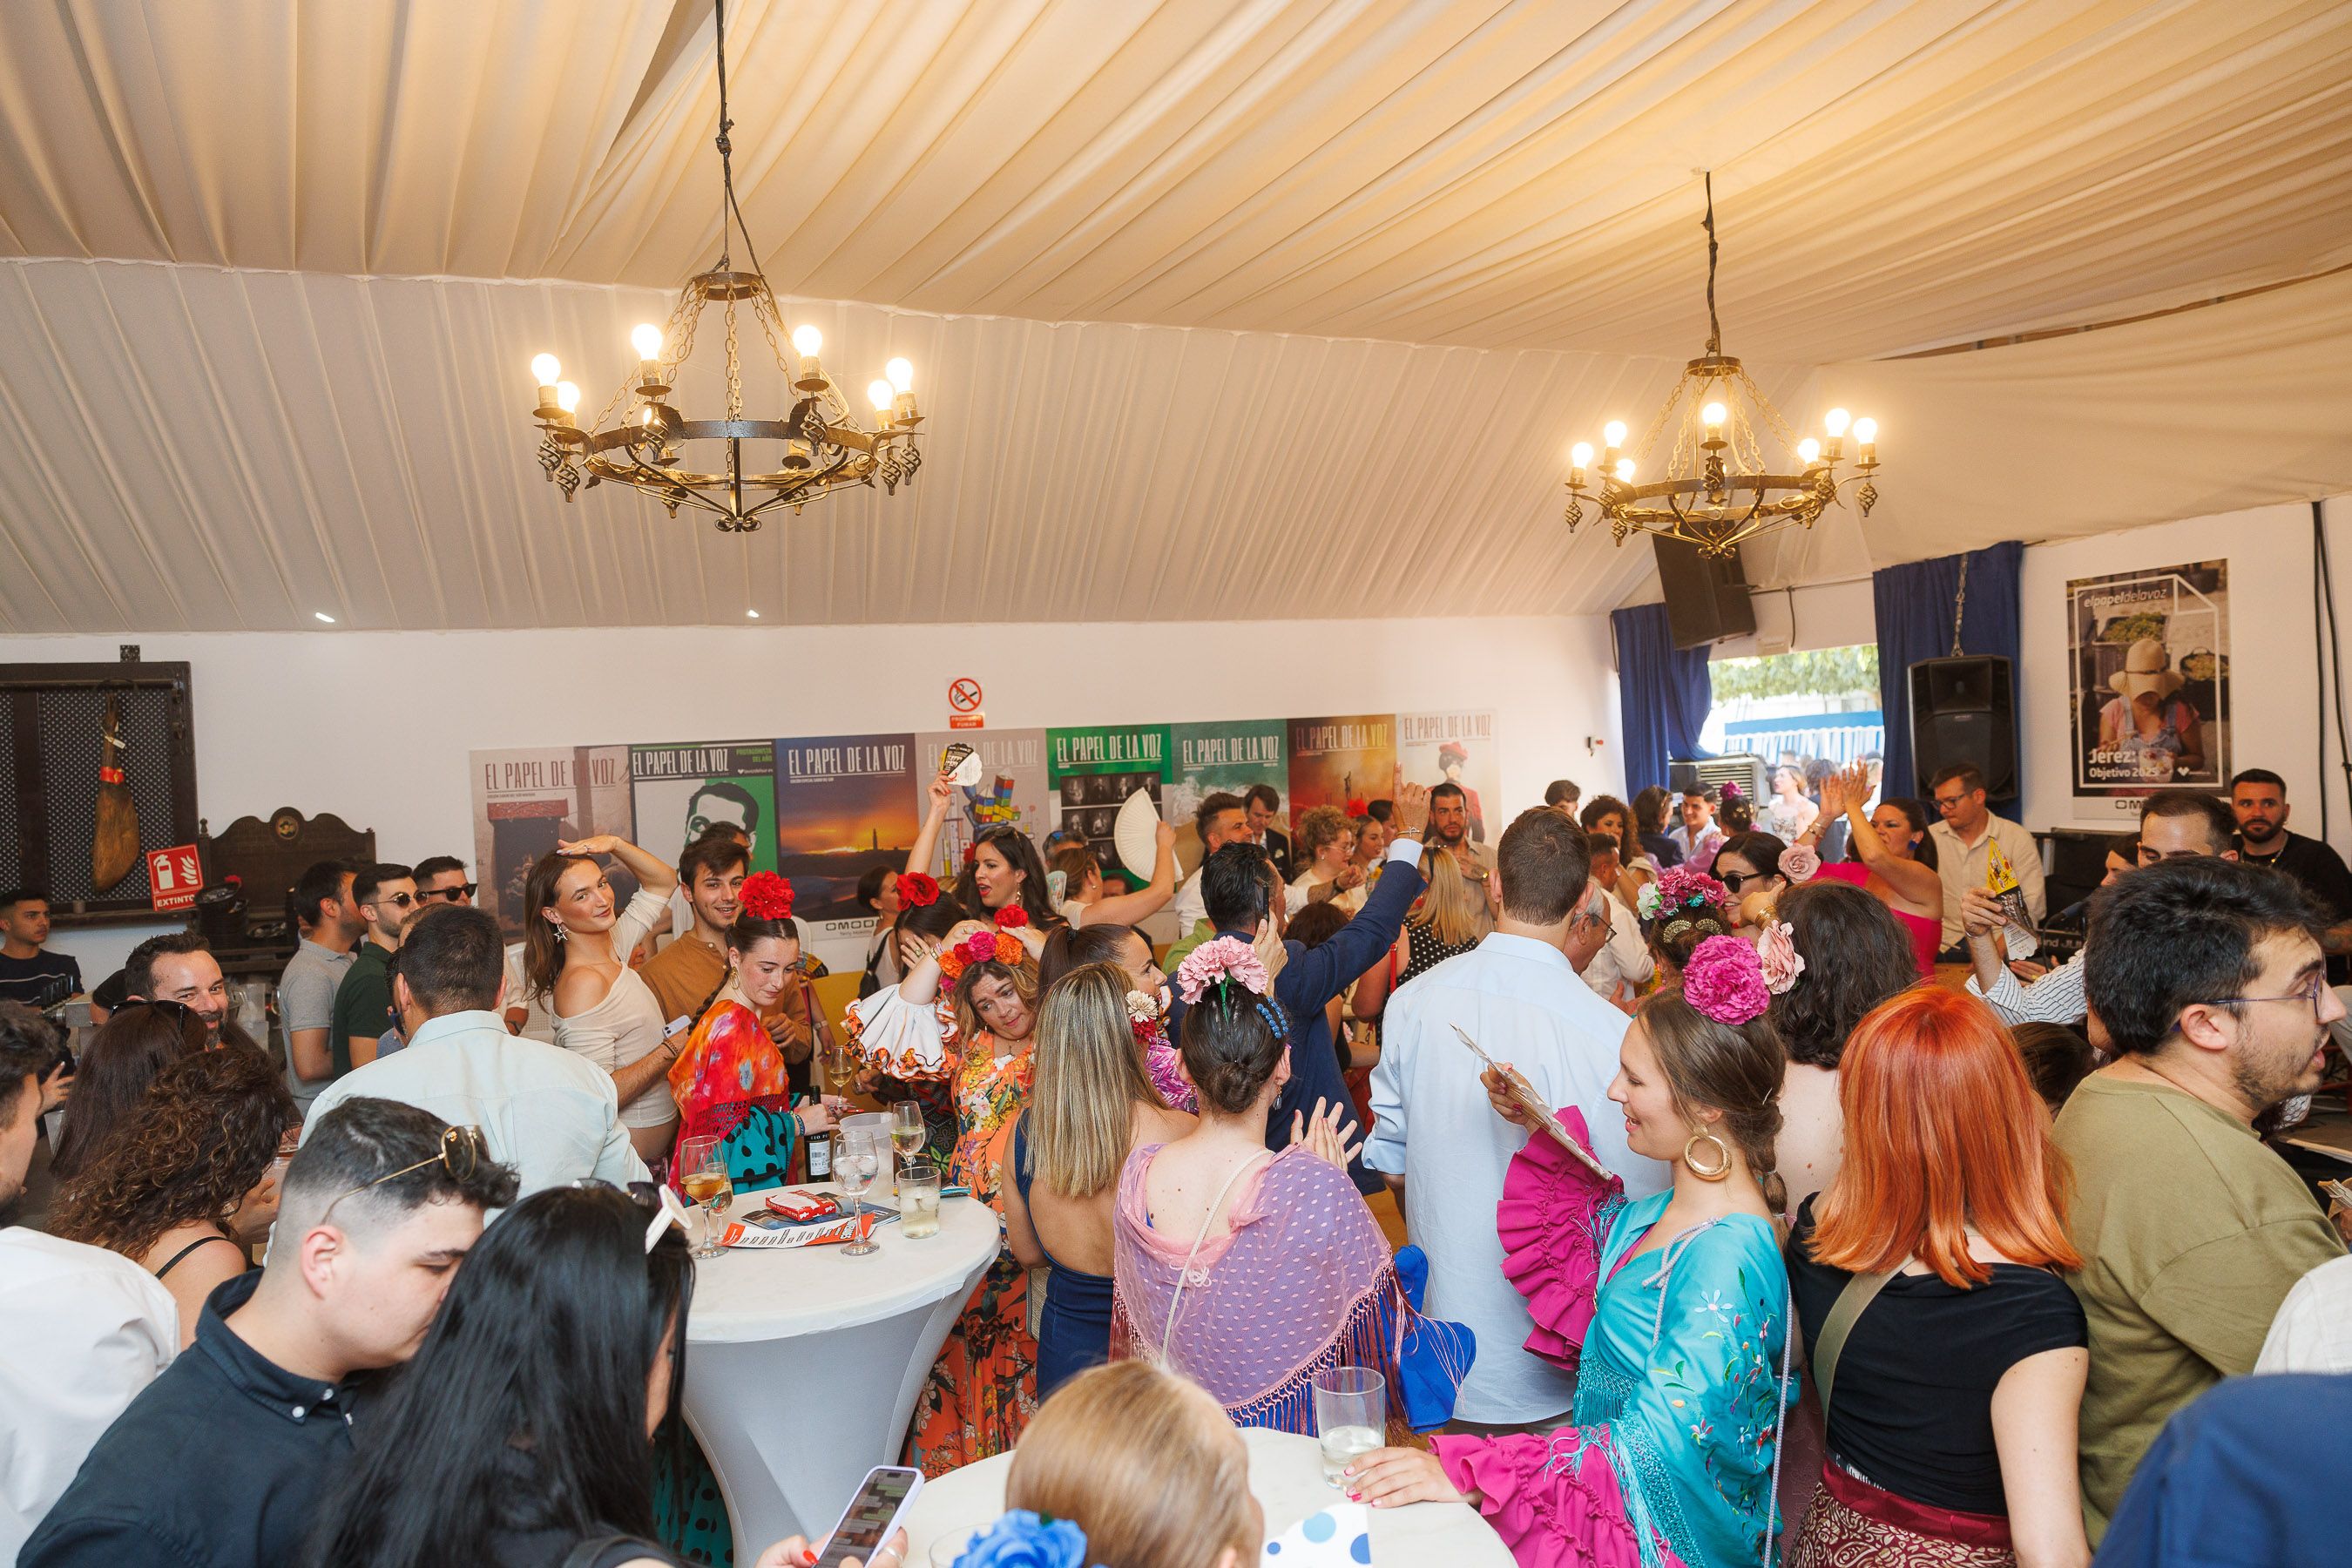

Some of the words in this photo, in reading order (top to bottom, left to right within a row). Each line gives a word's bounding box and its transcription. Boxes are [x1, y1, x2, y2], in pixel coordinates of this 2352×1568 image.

[1296, 727, 1306, 750] EL
[1310, 726, 1338, 749] PAPEL
[1342, 725, 1354, 748] DE
[1356, 724, 1368, 747] LA
[1370, 724, 1388, 747] VOZ
[1405, 718, 1413, 740] EL
[1417, 717, 1443, 739] PAPEL
[1448, 716, 1458, 738] DE
[1463, 715, 1472, 737] LA
[1476, 714, 1491, 736] VOZ
[788, 749, 801, 775] EL
[806, 747, 842, 774] PAPEL
[847, 747, 862, 773] DE
[866, 746, 881, 772] LA
[883, 745, 906, 771] VOZ
[928, 744, 938, 768] EL
[983, 741, 996, 766] DE
[1000, 740, 1014, 766] LA
[1017, 739, 1038, 763] VOZ
[1057, 738, 1069, 762] EL
[1072, 736, 1105, 761] PAPEL
[1109, 735, 1123, 760] DE
[1126, 734, 1139, 759] LA
[1142, 733, 1162, 758] VOZ
[1183, 740, 1193, 764] EL
[1198, 739, 1227, 763] PAPEL
[1231, 738, 1243, 761] DE
[1247, 737, 1259, 760] LA
[1261, 736, 1280, 760] VOZ
[2088, 749, 2137, 764] Jerez:
[485, 763, 499, 790] EL
[505, 761, 545, 788] PAPEL
[551, 760, 567, 787] DE
[572, 759, 588, 786] LA
[591, 758, 616, 785] VOZ
[632, 752, 644, 775] EL
[645, 750, 678, 775] PAPEL
[679, 749, 693, 774] DE
[696, 749, 708, 773] LA
[709, 748, 729, 772] VOZ
[2089, 767, 2131, 781] Objetivo
[157, 894, 195, 907] EXTINTO
[826, 920, 875, 931] OMOD
